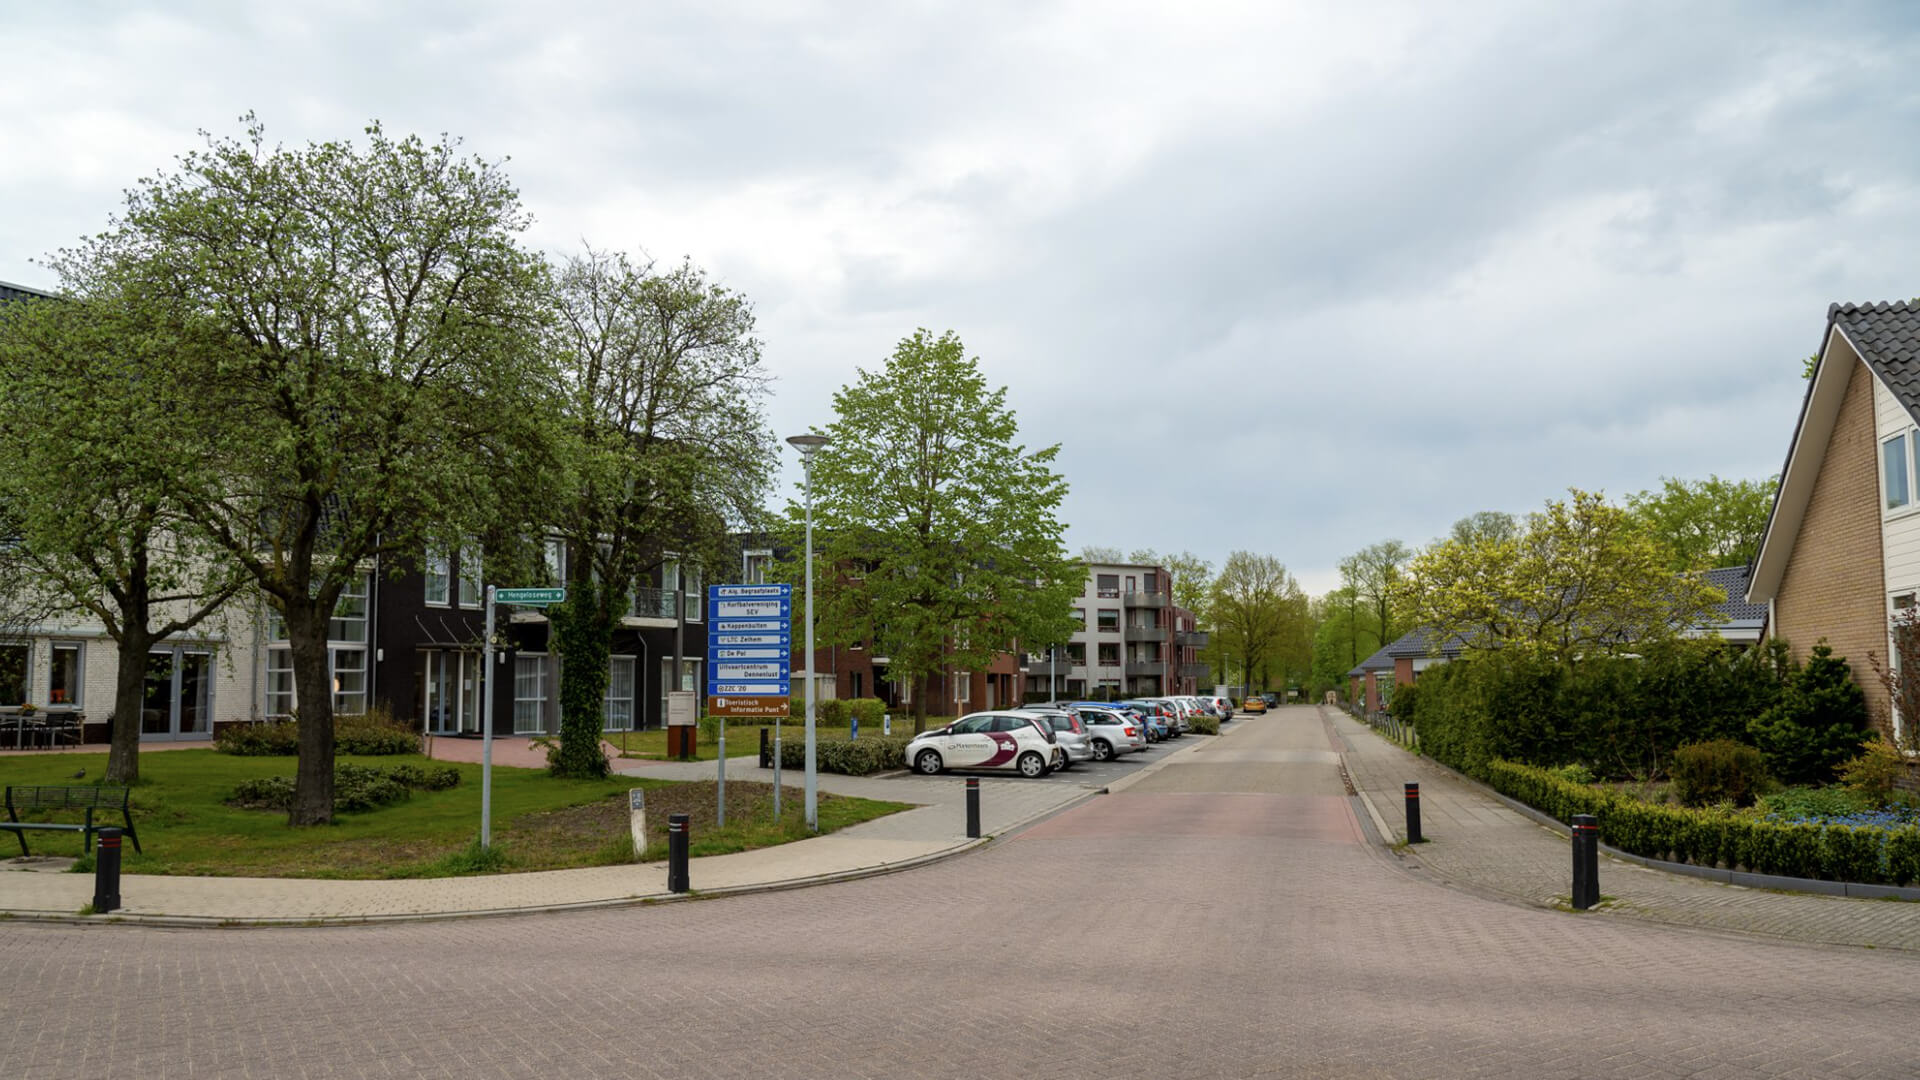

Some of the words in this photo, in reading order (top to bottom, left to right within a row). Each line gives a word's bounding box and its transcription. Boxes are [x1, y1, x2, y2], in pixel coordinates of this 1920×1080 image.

[507, 591, 553, 599] Hengeloseweg
[741, 587, 779, 595] Begraafplaats
[727, 601, 778, 609] Korfbalvereniging
